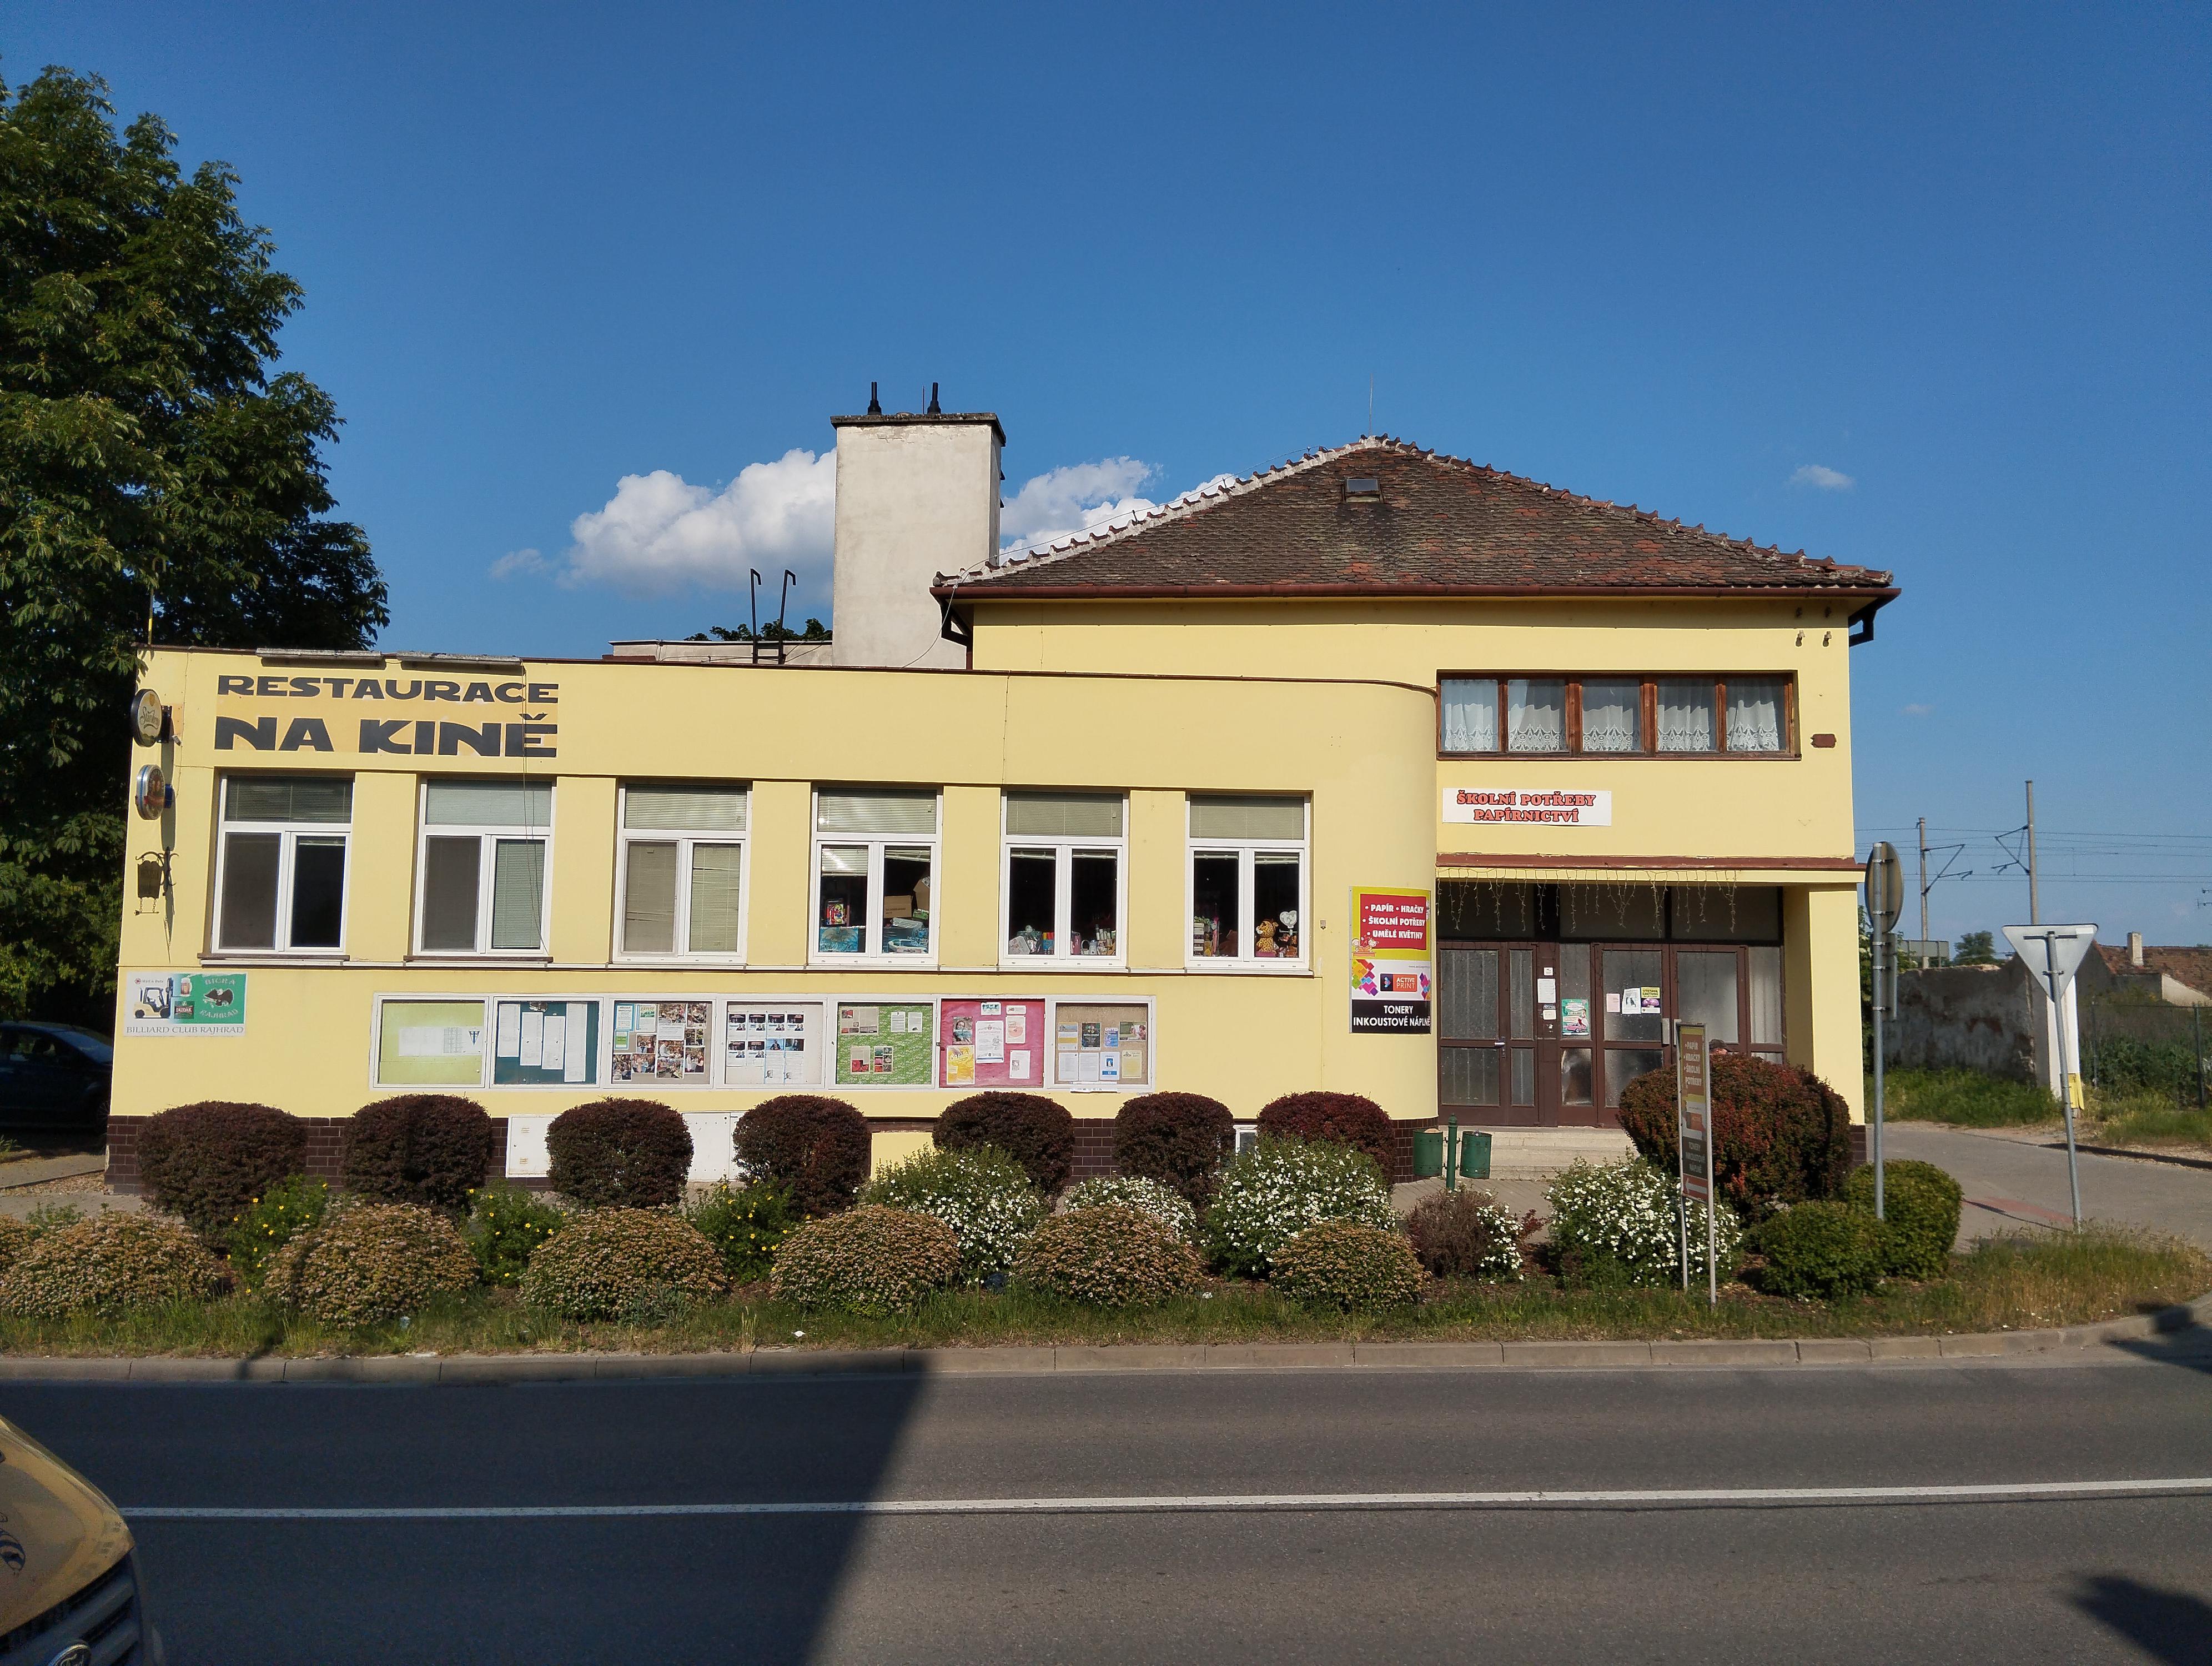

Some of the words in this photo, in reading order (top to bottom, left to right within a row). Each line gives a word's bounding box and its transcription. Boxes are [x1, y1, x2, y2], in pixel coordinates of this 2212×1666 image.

[218, 675, 559, 703] RESTAURACE
[214, 716, 334, 752] NA
[358, 712, 557, 757] KINĚ
[1456, 789, 1516, 806] ŠKOLNÍ
[1520, 790, 1597, 807] POTŘEBY
[1473, 807, 1579, 823] PAPÍRNICTVÍ
[1370, 904, 1394, 912] PAPÍR
[1400, 904, 1424, 914] HRAČKY
[1368, 915, 1398, 926] ŠKOLNÍ
[1399, 917, 1425, 927] POTŘEBY
[1372, 929, 1397, 938] UMĚLÉ
[1398, 930, 1423, 940] KVĚTINY
[1383, 1005, 1414, 1015] TONERY
[1353, 1015, 1408, 1026] INKOUSTOVÉ
[1409, 1016, 1431, 1027] NÁPLNĚ
